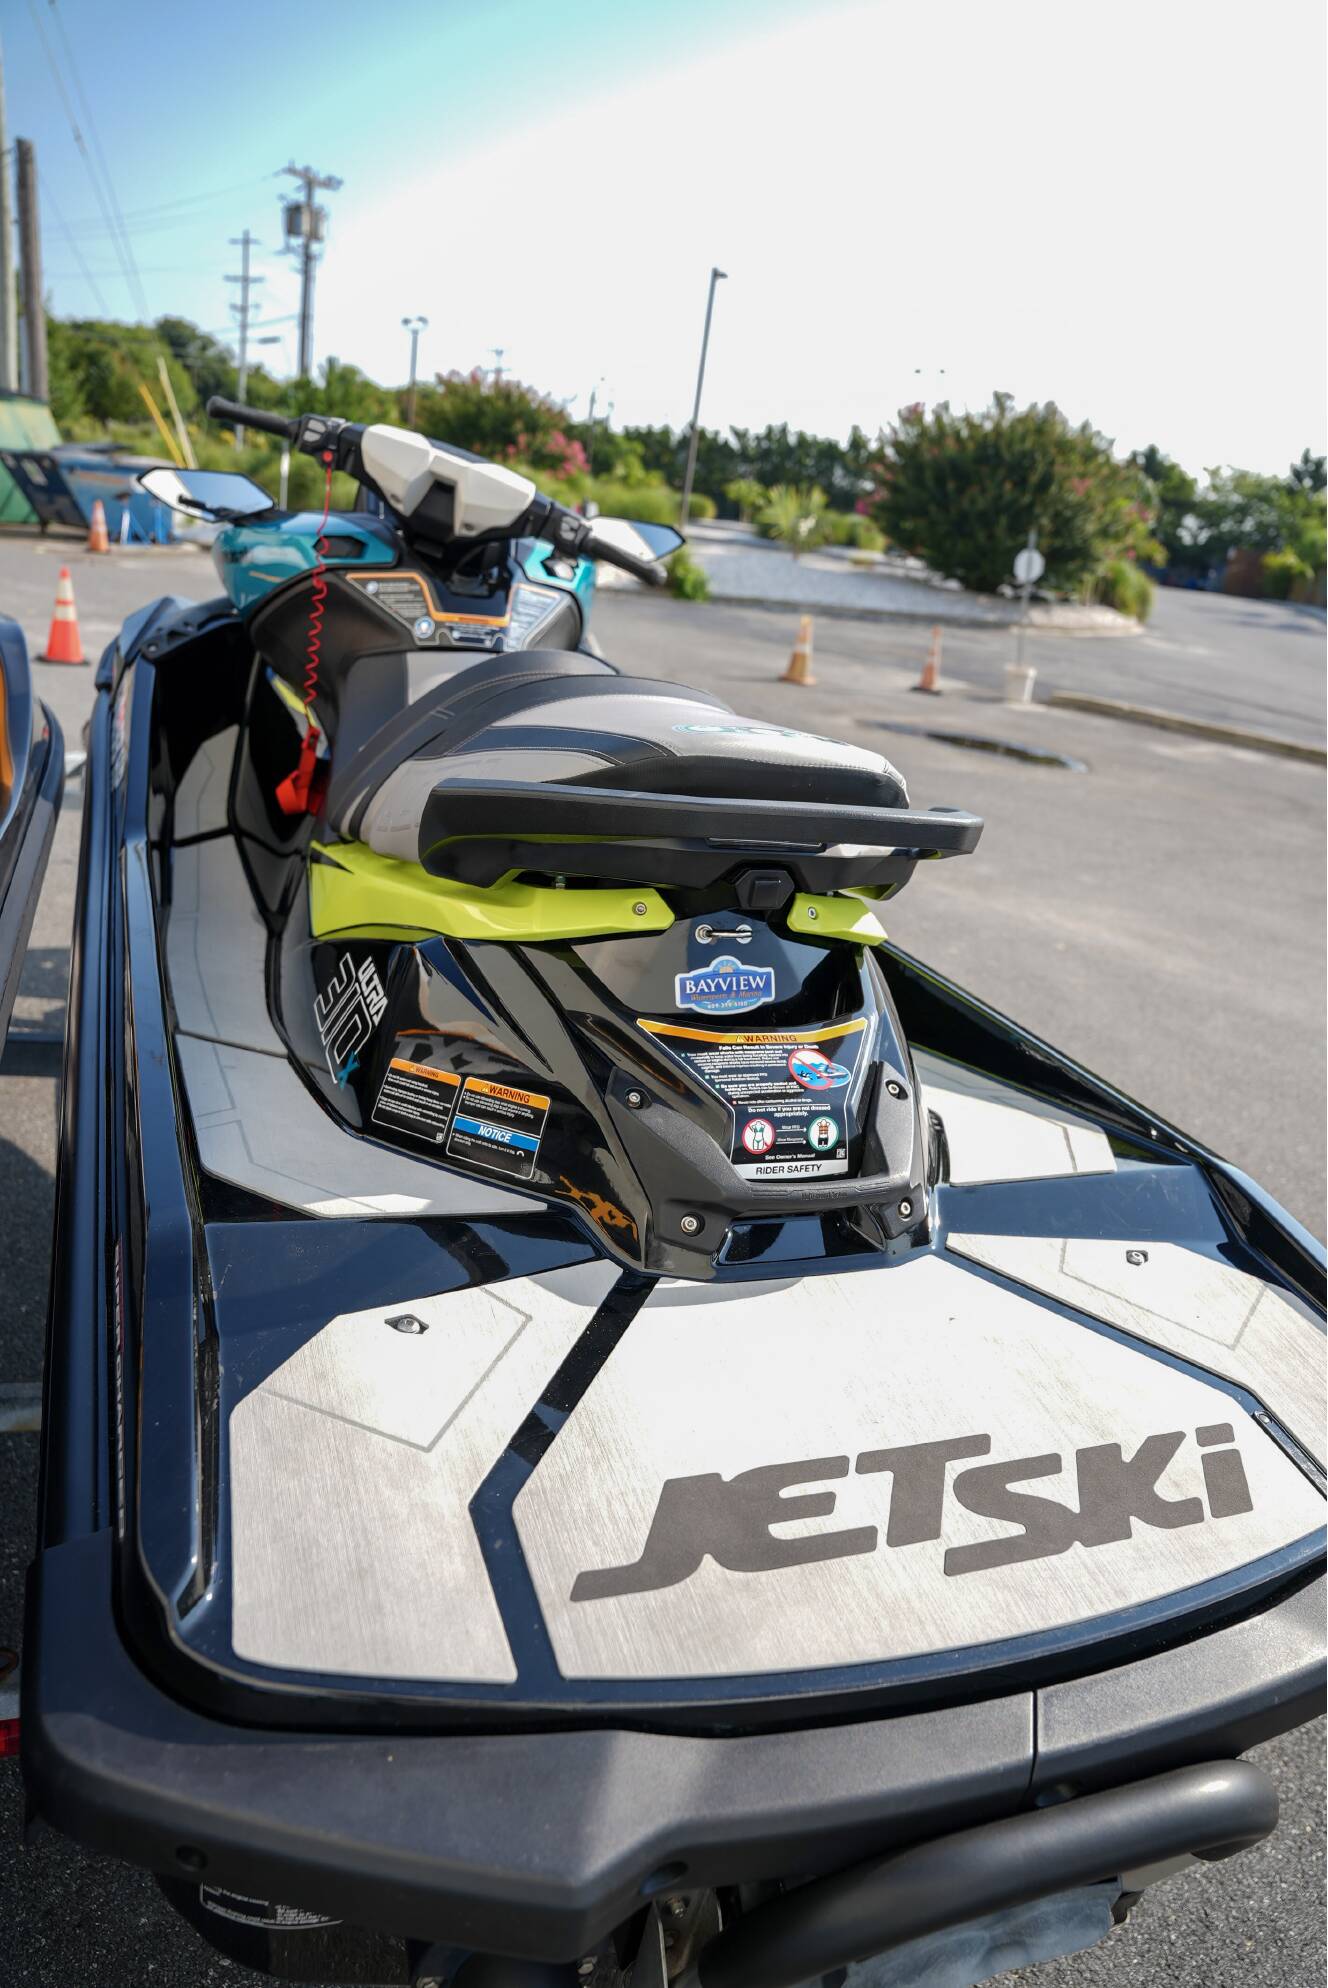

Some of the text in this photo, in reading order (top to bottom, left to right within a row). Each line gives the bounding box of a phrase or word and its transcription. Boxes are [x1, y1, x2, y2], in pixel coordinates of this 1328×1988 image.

[357, 955, 388, 1027] ULTRA
[685, 975, 767, 994] BAYVIEW
[744, 1035, 797, 1043] WARNING
[415, 1065, 440, 1078] WARNING
[489, 1084, 531, 1104] WARNING
[477, 1125, 513, 1143] NOTICE
[755, 1164, 823, 1176] RIDER SAFETY
